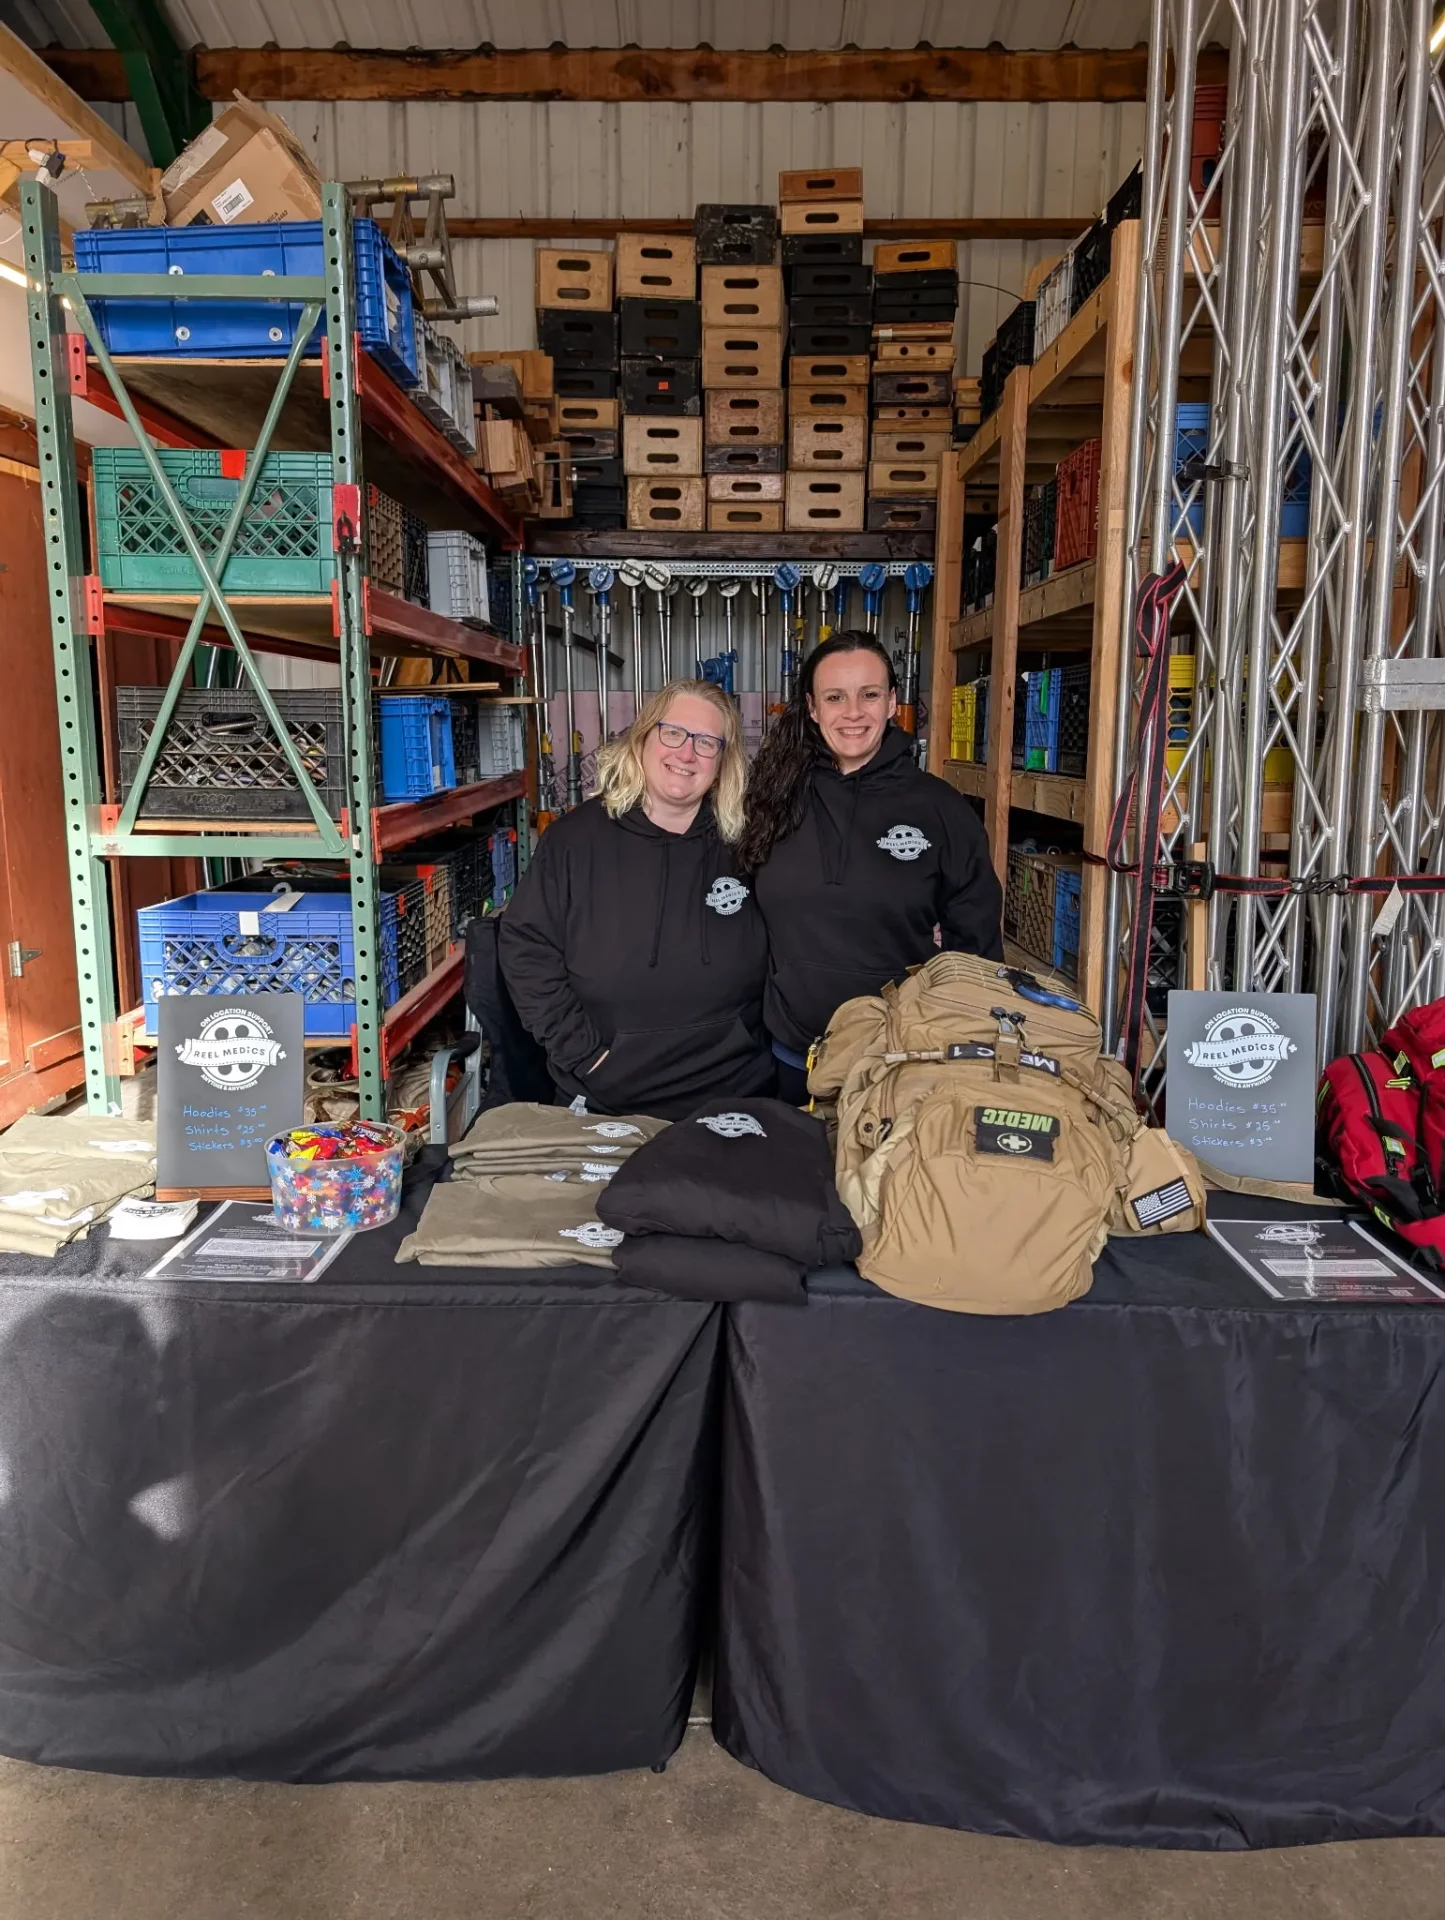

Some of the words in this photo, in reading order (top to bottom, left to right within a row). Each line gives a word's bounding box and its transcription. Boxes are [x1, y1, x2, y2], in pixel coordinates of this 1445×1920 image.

[200, 1016, 211, 1028] ON
[210, 1008, 247, 1021] LOCATION
[247, 1010, 274, 1035] SUPPORT
[1204, 1019, 1215, 1030] ON
[1213, 1007, 1249, 1022] LOCATION
[1250, 1008, 1280, 1030] SUPPORT
[193, 1050, 219, 1059] REEL
[1202, 1051, 1228, 1060] REEL
[200, 1074, 224, 1090] ANYTIME
[228, 1079, 259, 1091] ANYWHERE
[1212, 1074, 1238, 1089] ANYTIME
[1242, 1074, 1273, 1089] ANYWHERE
[183, 1104, 231, 1119] Hoodies
[1188, 1098, 1246, 1114] Hoodies
[981, 1108, 1053, 1133] MEDIC
[1188, 1117, 1237, 1130] Shirts
[185, 1124, 230, 1136] Shirts
[188, 1140, 235, 1151] Stickers
[1192, 1134, 1245, 1148] Stickers
